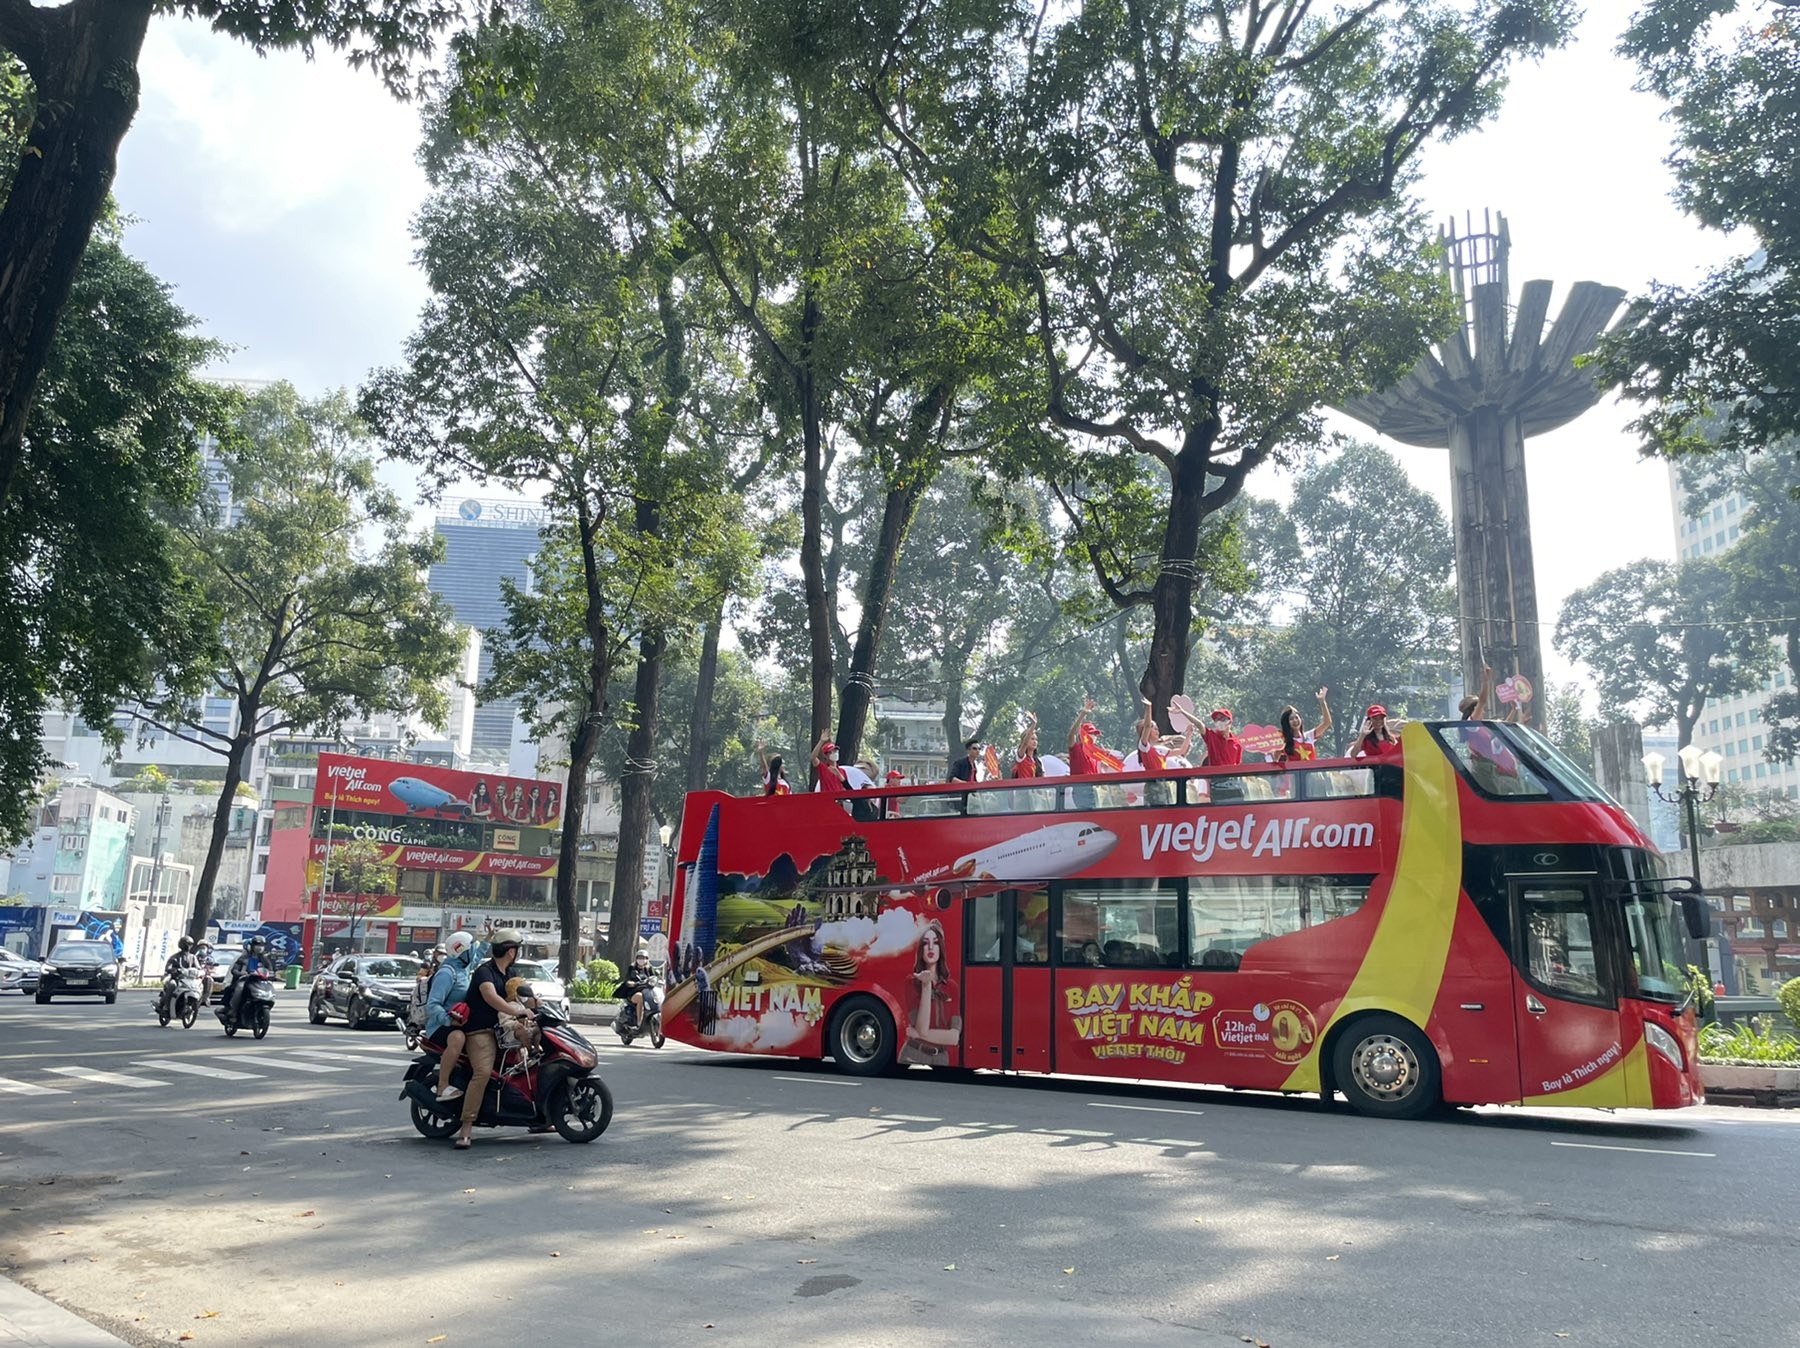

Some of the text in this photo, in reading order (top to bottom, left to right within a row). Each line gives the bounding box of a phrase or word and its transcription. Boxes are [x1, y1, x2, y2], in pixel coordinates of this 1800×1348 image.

[324, 792, 337, 801] Ba
[1140, 814, 1375, 863] Vietjet Air.com
[769, 987, 821, 1013] NAM
[1065, 975, 1214, 1015] BAY KHẮP
[1073, 1009, 1205, 1046] VIỆT NAM
[1224, 1020, 1244, 1032] 12h
[1221, 1032, 1254, 1044] Vietjet
[1541, 1080, 1562, 1092] Bay
[1561, 1072, 1573, 1085] là
